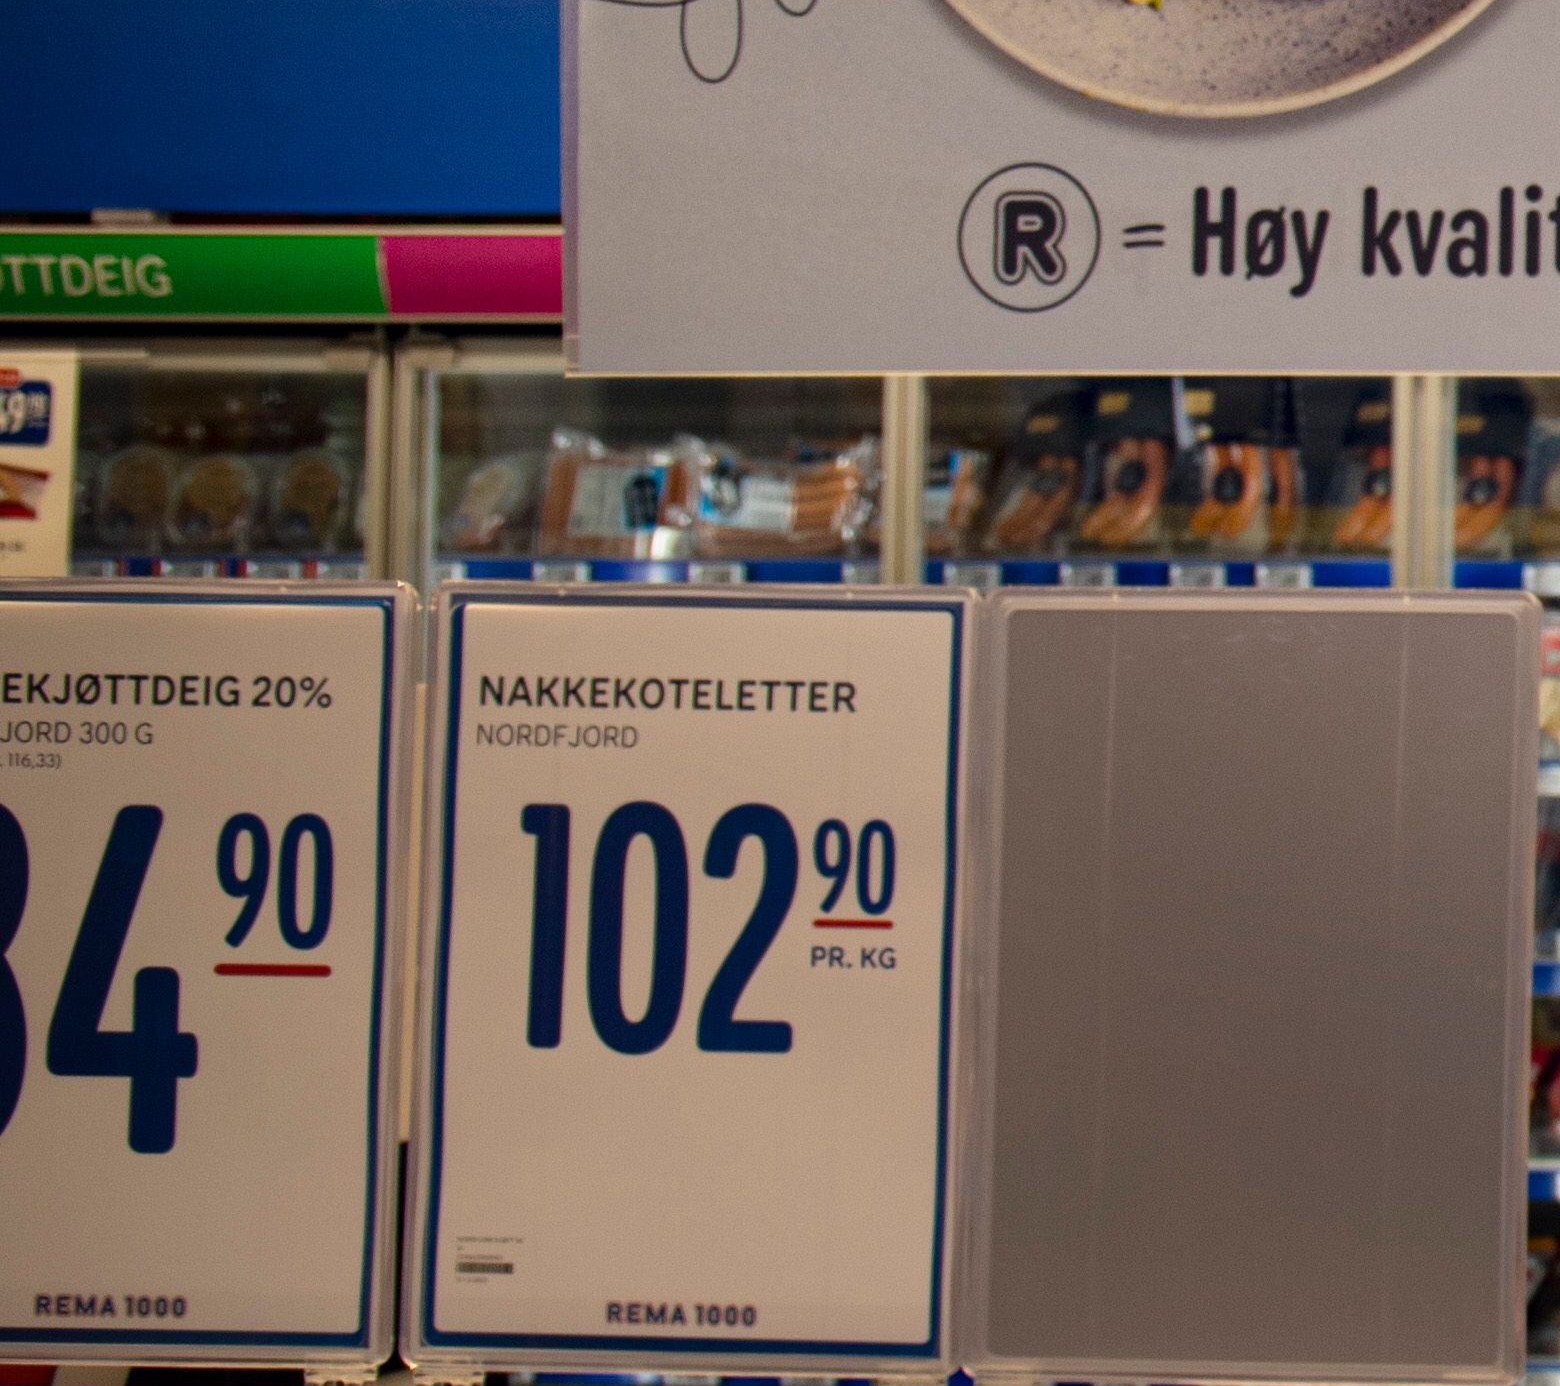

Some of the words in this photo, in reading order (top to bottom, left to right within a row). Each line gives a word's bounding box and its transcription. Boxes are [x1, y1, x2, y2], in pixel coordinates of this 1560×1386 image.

[993, 195, 1066, 285] R
[1192, 186, 1328, 297] Høy
[0, 253, 172, 297] TTDEIG
[2, 673, 241, 708] EKJØTTDEIG
[251, 676, 333, 709] 20%
[480, 676, 855, 712] NAKKEKOTELETTER
[80, 723, 129, 745] 300
[134, 725, 153, 745] G
[476, 723, 638, 748] NORDFJORD
[214, 812, 334, 951] 90
[521, 801, 798, 1055] 102
[814, 819, 895, 915] 90
[811, 946, 852, 968] PR.
[861, 947, 896, 969] KG
[35, 1296, 116, 1317] REMA
[125, 1295, 187, 1317] 1000
[606, 1302, 686, 1324] REMA
[695, 1304, 756, 1327] 1000
